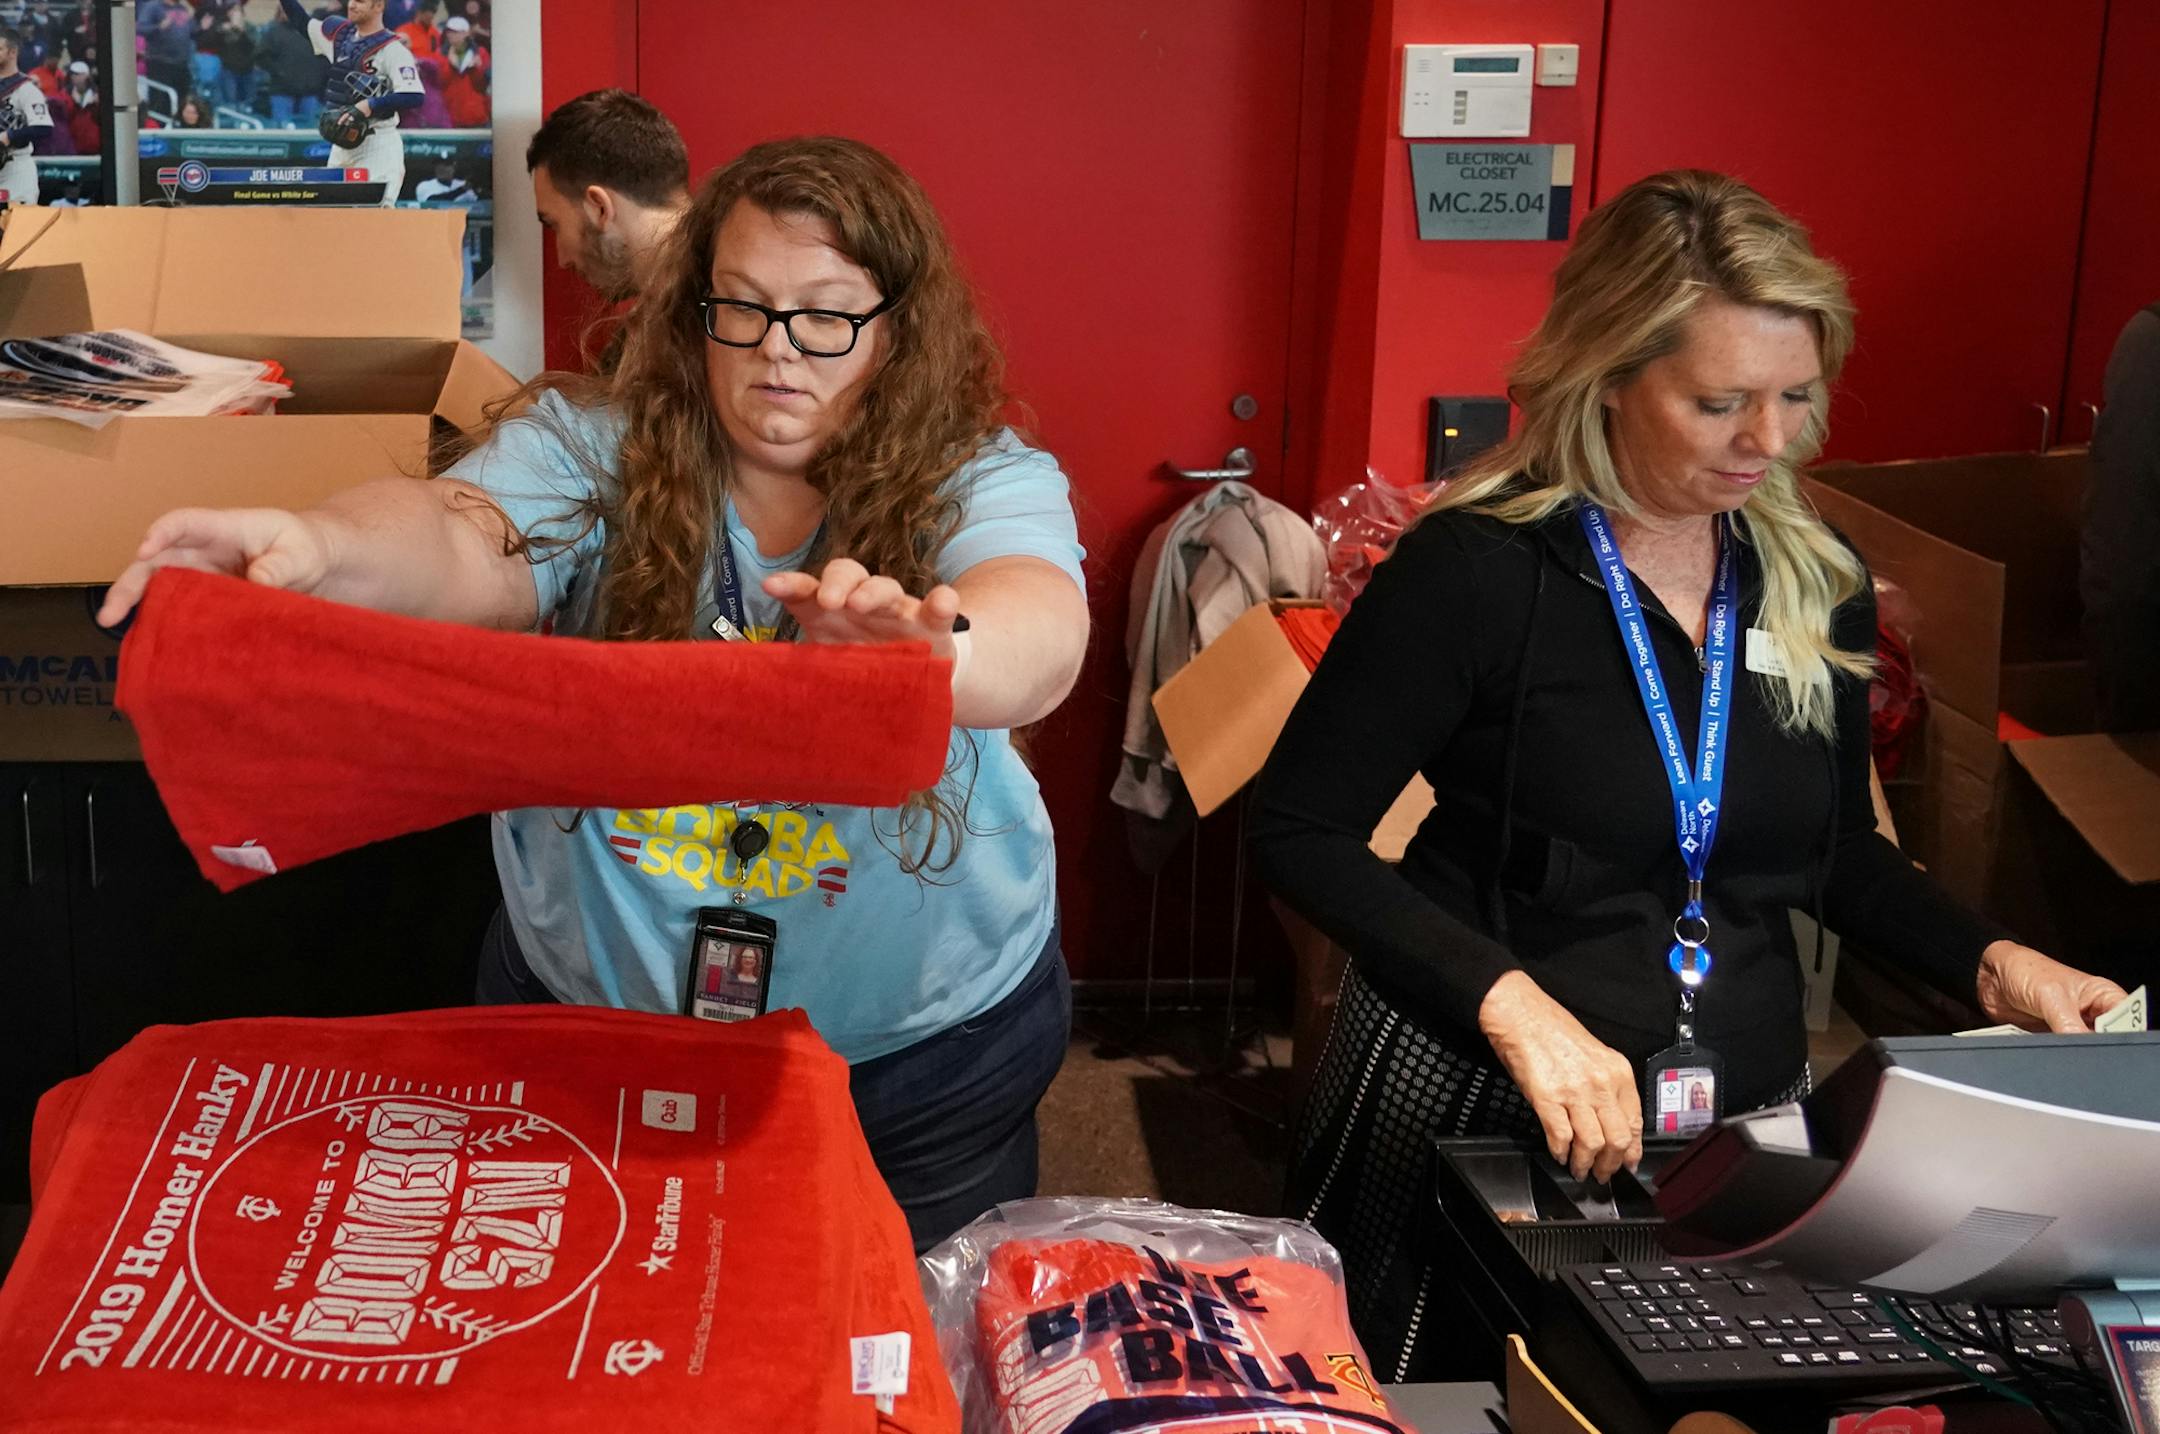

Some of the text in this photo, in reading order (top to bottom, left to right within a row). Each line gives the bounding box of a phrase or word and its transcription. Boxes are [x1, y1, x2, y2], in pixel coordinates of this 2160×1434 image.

[1446, 152, 1533, 166] ELECTRICAL
[249, 170, 303, 181] JOE MAUER
[352, 171, 361, 179] C
[1460, 167, 1518, 179] CLOSET
[234, 191, 251, 199] Final
[252, 191, 271, 199] Game
[281, 191, 301, 199] White
[1428, 192, 1544, 213] MC.25.04
[721, 556, 732, 585] Come
[1716, 604, 1726, 618] Do
[1588, 509, 1686, 785] Lean Forward Come Together Do Right Stand Up
[1713, 621, 1726, 647] Right
[1711, 660, 1723, 690] Stand
[1708, 691, 1721, 707] Up
[1706, 721, 1718, 748] Think
[1703, 750, 1715, 782] Guest
[1688, 810, 1697, 834] North
[640, 837, 813, 898] SQUAD
[2131, 1000, 2142, 1028] 20
[661, 1100, 677, 1123] Cub
[60, 1064, 249, 1370] 2019 Homer Hanky
[273, 1140, 346, 1291] WELCOME TO
[290, 1102, 470, 1345] BOMBA
[440, 1161, 571, 1290] SZN
[1027, 1279, 1243, 1354] BASE
[2126, 1340, 2160, 1352] TARG
[1121, 1328, 1339, 1394] BALL
